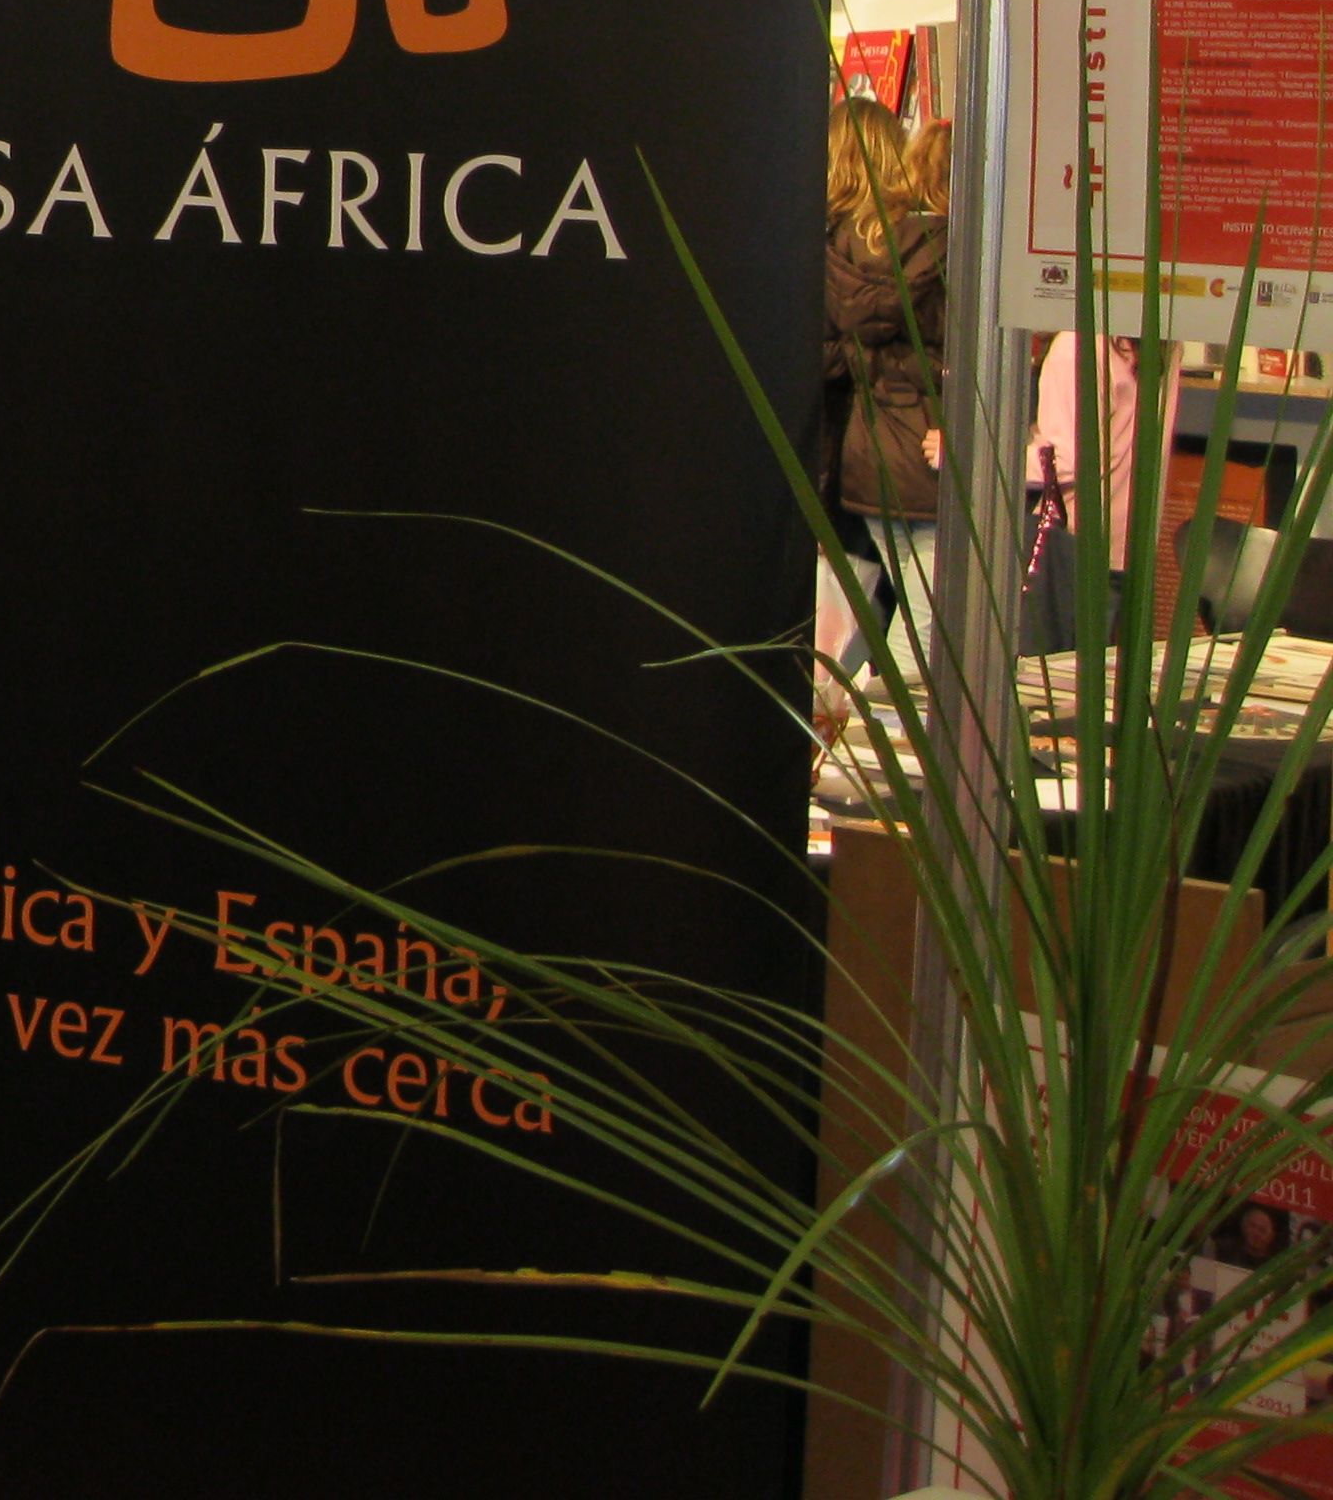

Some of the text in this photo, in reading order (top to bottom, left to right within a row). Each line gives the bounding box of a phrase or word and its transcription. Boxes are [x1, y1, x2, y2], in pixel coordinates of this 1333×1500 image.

[154, 122, 628, 260] ÁFRICA
[131, 901, 177, 975] y
[6, 993, 125, 1066] vez
[343, 1048, 553, 1134] cerca
